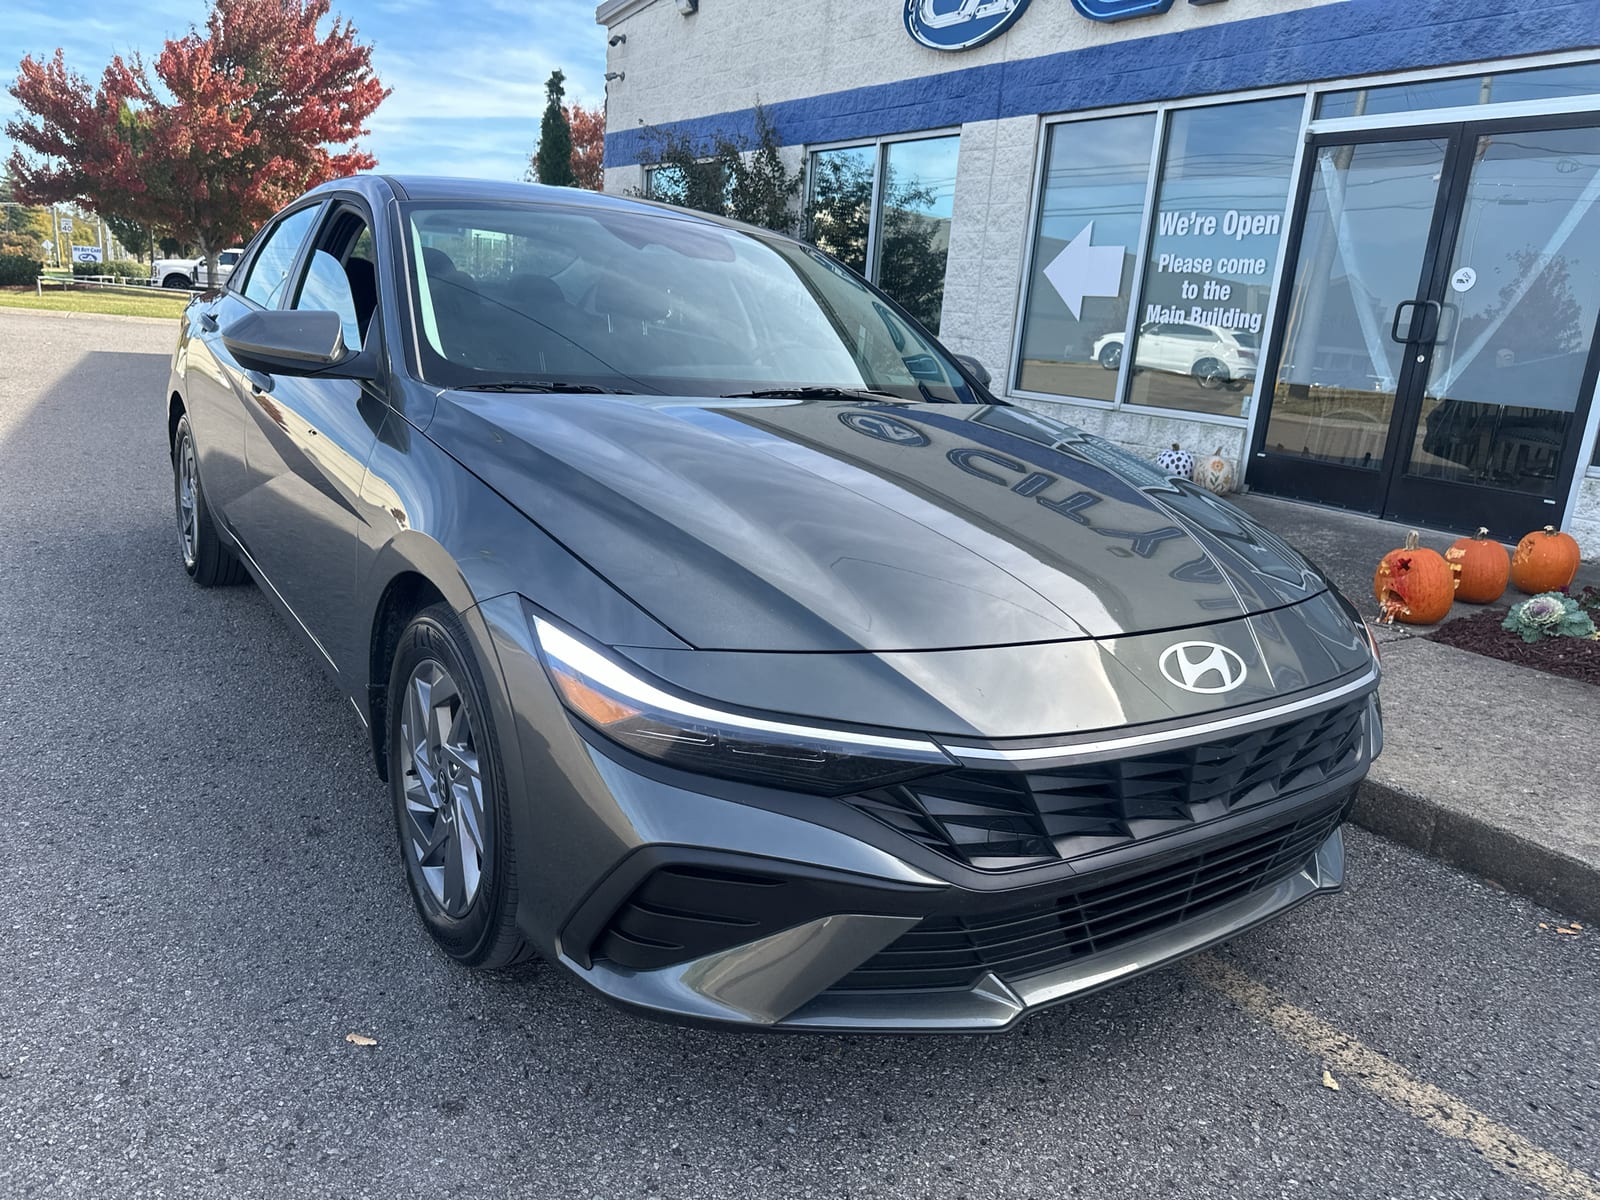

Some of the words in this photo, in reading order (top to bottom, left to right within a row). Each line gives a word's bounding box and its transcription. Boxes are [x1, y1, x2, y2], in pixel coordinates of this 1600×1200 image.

[1159, 211, 1217, 236] We're
[1223, 210, 1280, 241] Open
[1158, 254, 1213, 273] Please
[1217, 257, 1266, 275] come
[1181, 280, 1198, 299] to
[1203, 281, 1231, 300] the
[1145, 304, 1185, 325] Main
[1190, 306, 1263, 333] Building
